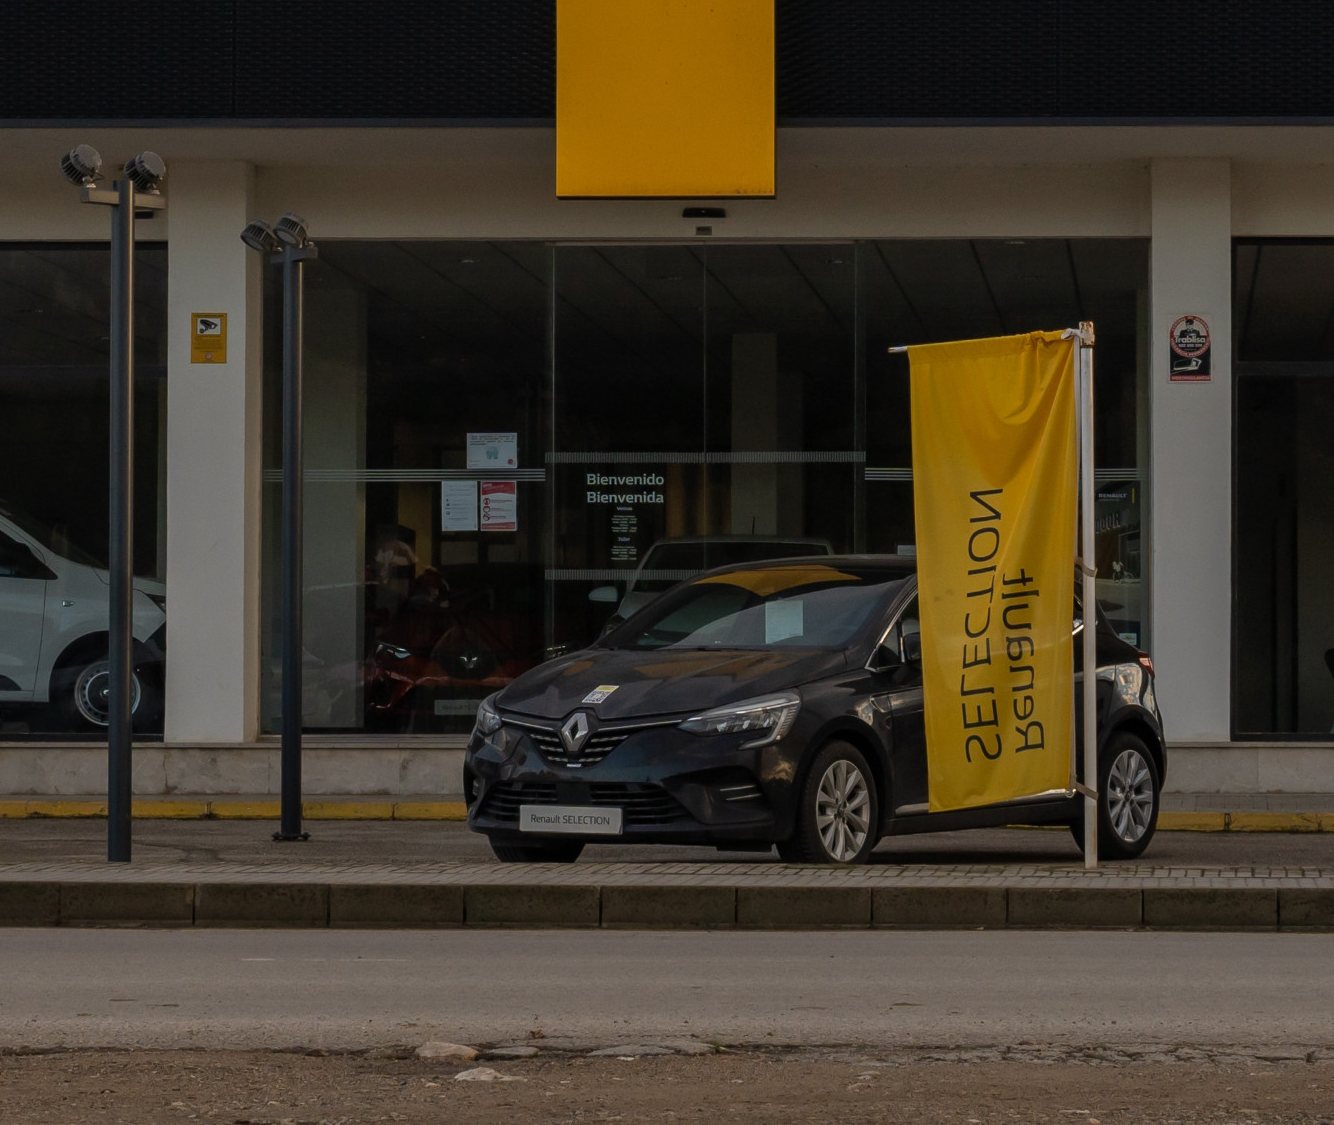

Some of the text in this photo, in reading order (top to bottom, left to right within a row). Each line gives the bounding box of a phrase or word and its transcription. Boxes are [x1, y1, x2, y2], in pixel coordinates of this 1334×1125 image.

[586, 473, 665, 486] Bienvenido
[586, 491, 665, 504] Bienvenida
[530, 813, 611, 826] Renault SELECTION
